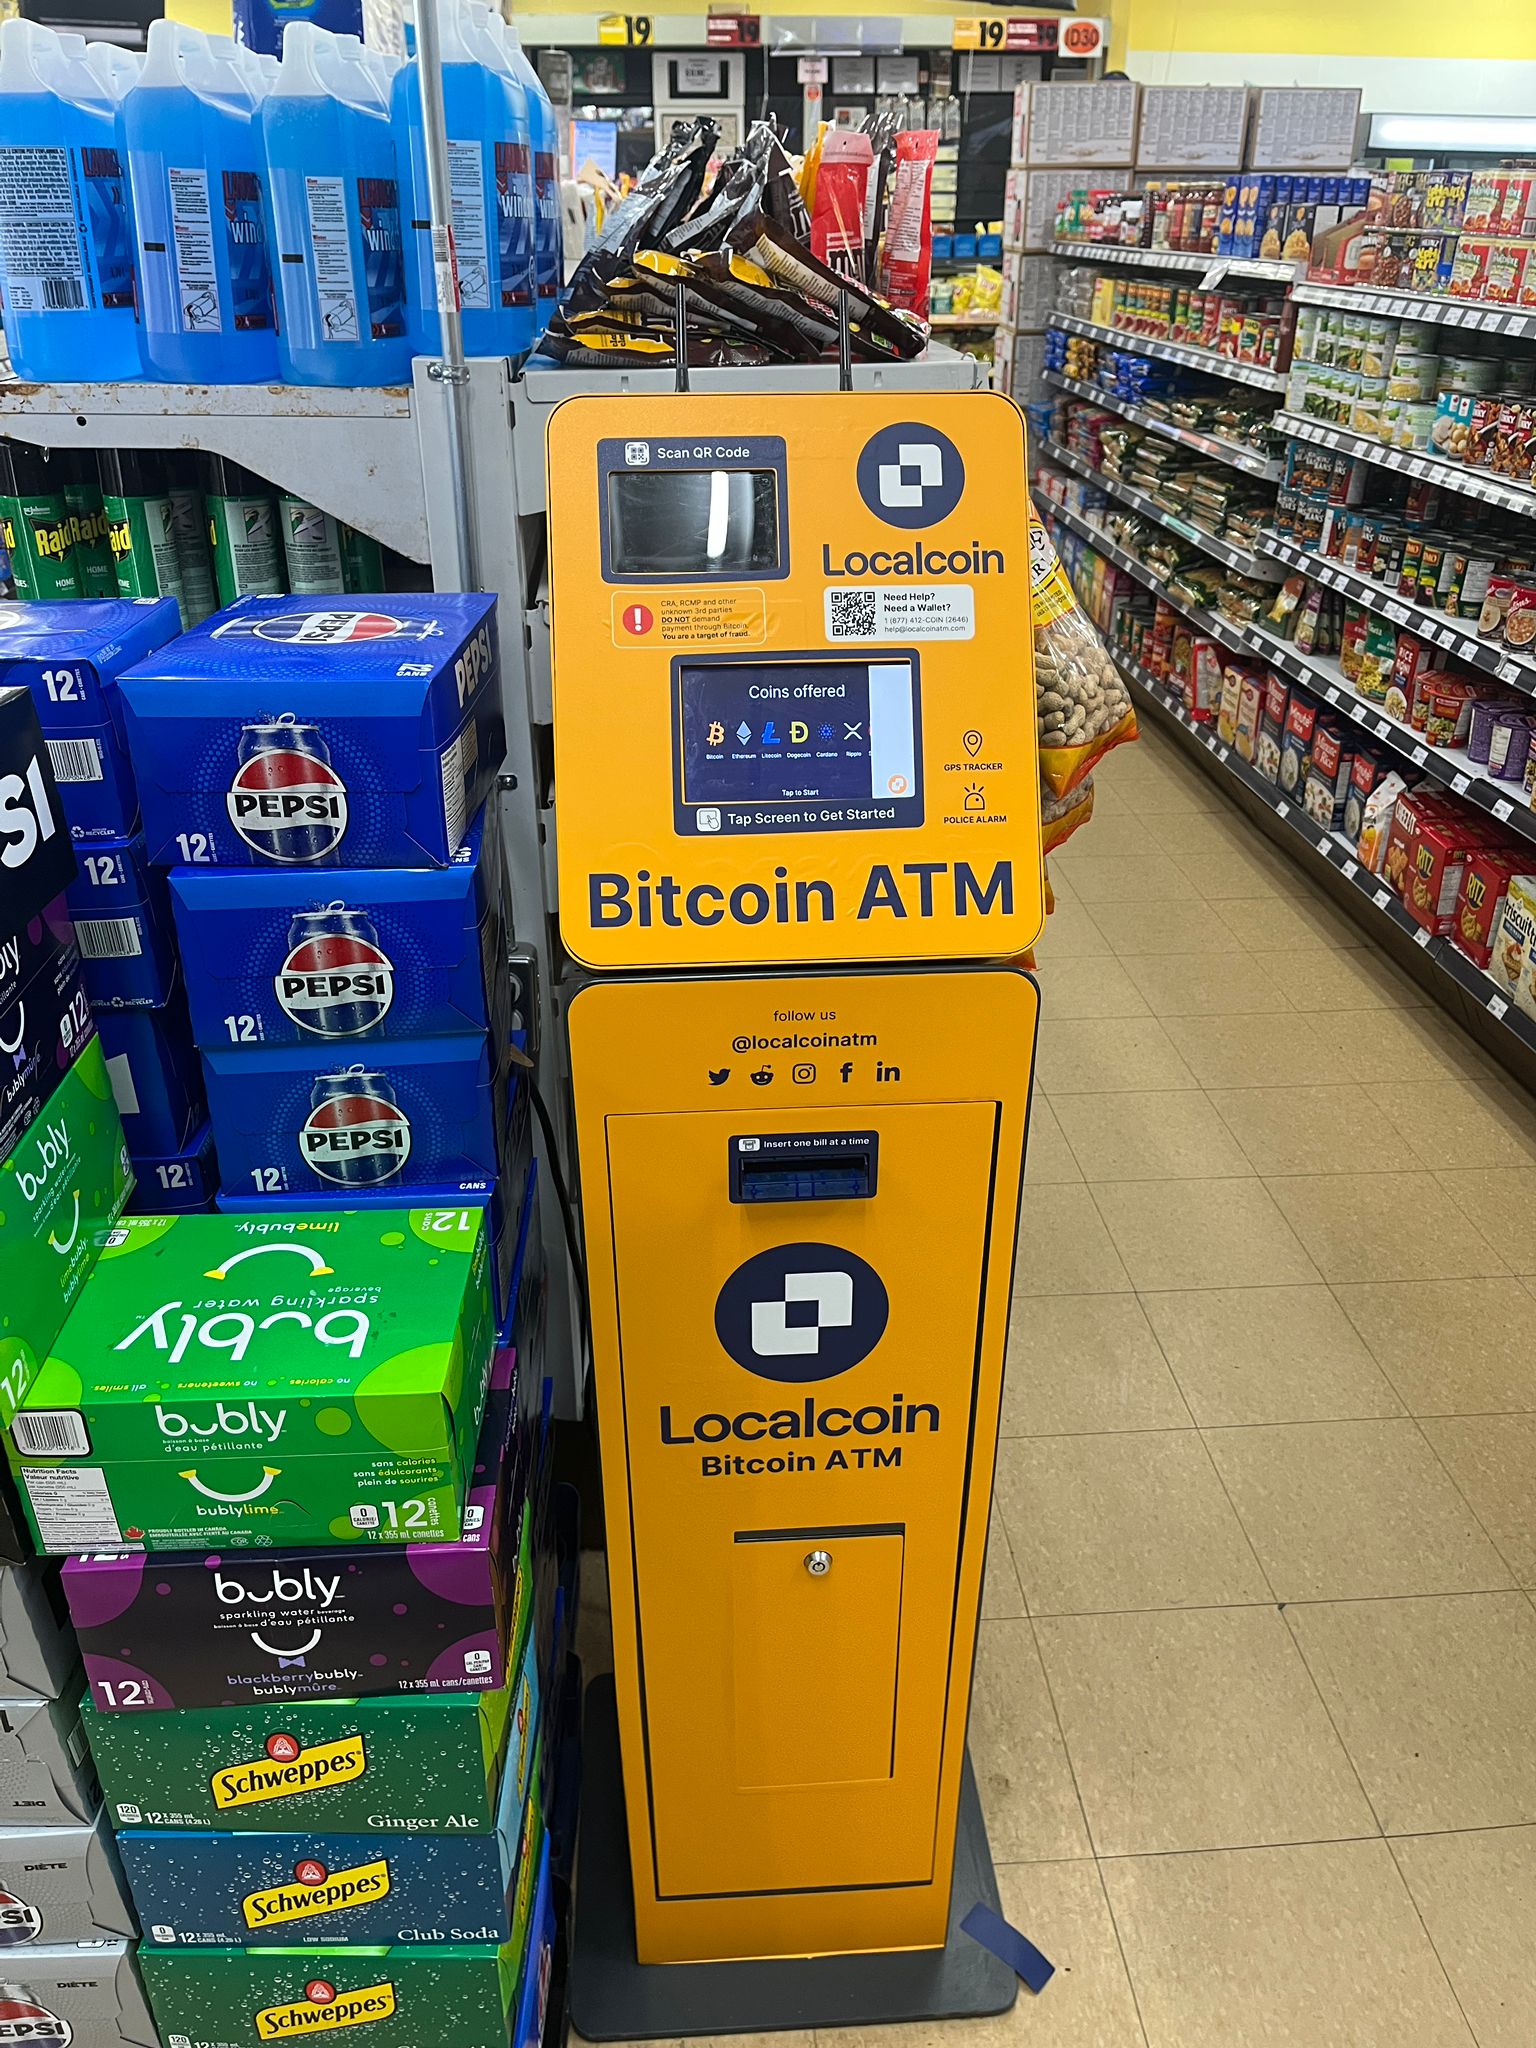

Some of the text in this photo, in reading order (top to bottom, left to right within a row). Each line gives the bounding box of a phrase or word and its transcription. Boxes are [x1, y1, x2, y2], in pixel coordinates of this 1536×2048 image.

[624, 16, 651, 45] 19
[979, 21, 1003, 47] 19
[657, 446, 750, 459] Scan QR Code
[69, 511, 109, 544] Raid
[35, 522, 73, 558] Raid
[822, 540, 1005, 577] Localcoin
[86, 565, 108, 575] HOME
[55, 578, 76, 588] HOME
[679, 599, 701, 607] RCMP
[883, 592, 936, 603] Need Help?
[708, 606, 733, 616] parties
[883, 604, 908, 612] Need
[917, 603, 951, 612] Wallet?
[299, 612, 357, 642] PEPSI
[661, 616, 673, 624] DO
[889, 616, 907, 625] (877)
[909, 616, 944, 624] 412-COIN
[945, 615, 969, 624] (2646)
[661, 624, 693, 633] payment
[694, 623, 722, 632] through
[696, 632, 719, 640] target
[728, 630, 751, 638] fraud.
[884, 624, 966, 633] help@localcoinatm.com
[453, 622, 494, 710] PEPSI
[41, 669, 79, 702] 12
[748, 683, 846, 700] Coins offered
[786, 752, 812, 760] Dogecoin
[943, 762, 1003, 772] GPS TRACKER
[782, 789, 794, 797] Tap
[803, 788, 819, 796] Start
[234, 793, 341, 819] PEPSI
[727, 807, 896, 826] Tap Screen to Get Started
[943, 815, 1007, 824] POLICE ALARM
[175, 833, 211, 863] 12
[1416, 843, 1435, 878] RITZ
[83, 856, 119, 886] 12
[587, 860, 1015, 929] Bitcoin ATM
[1465, 871, 1487, 908] RITZ
[1503, 897, 1532, 937] triscuit
[282, 974, 386, 999] PEPSI
[773, 1008, 837, 1022] follow us
[224, 1014, 258, 1043] 12
[731, 1032, 878, 1054] @localcoinatm
[306, 1129, 404, 1153] PEPSI
[763, 1140, 791, 1149] Insert
[793, 1140, 812, 1148] one
[813, 1139, 827, 1147] bill
[829, 1139, 839, 1147] at
[848, 1137, 870, 1146] time
[16, 1118, 71, 1202] bubly
[155, 1163, 187, 1190] 12
[251, 1167, 282, 1192] 12
[458, 1181, 487, 1190] CANS
[421, 1212, 433, 1232] cans
[432, 1211, 472, 1232] 12
[327, 1286, 382, 1294] beverage
[193, 1293, 379, 1310] sparkling water
[114, 1301, 371, 1364] bubly
[1, 1358, 27, 1410] 12
[132, 1383, 147, 1391] all
[177, 1379, 241, 1389] sweeteners
[288, 1377, 334, 1386] calories
[154, 1401, 287, 1442] bubly
[660, 1393, 940, 1445] Localcoin
[164, 1441, 264, 1454] d'eau pétillante
[371, 1458, 437, 1468] sans calories
[701, 1447, 902, 1477] Bitcoin ATM
[378, 1467, 438, 1477] édulcorants
[357, 1475, 439, 1488] plein de sourires
[195, 1503, 280, 1518] bublylime
[360, 1508, 367, 1518] 0
[381, 1499, 428, 1528] 12
[427, 1496, 440, 1527] canettes
[467, 1508, 475, 1519] 0
[367, 1529, 445, 1540] 12 355 canettes
[462, 1533, 481, 1543] cans
[214, 1567, 342, 1608] bubly
[219, 1608, 316, 1621] sparkling water
[259, 1614, 356, 1628] d'eau pétillante
[474, 1652, 481, 1661] 0
[252, 1682, 338, 1696] bublymûre
[398, 1675, 493, 1690] 12 355 cans/canettes
[97, 1680, 146, 1707] 12
[220, 1748, 358, 1804] Schweppes
[119, 1805, 137, 1815] 120
[144, 1811, 164, 1825] 12
[366, 1813, 480, 1831] Ginger Ale
[24, 1862, 68, 1872] DIÈTE
[250, 1872, 384, 1923] Schweppes
[159, 1926, 166, 1935] 0
[178, 1931, 198, 1944] 12
[397, 1926, 500, 1942] Club Soda
[56, 1981, 99, 1989] DIÈTE
[265, 1994, 389, 2035] Schweppes
[170, 2036, 188, 2044] 120
